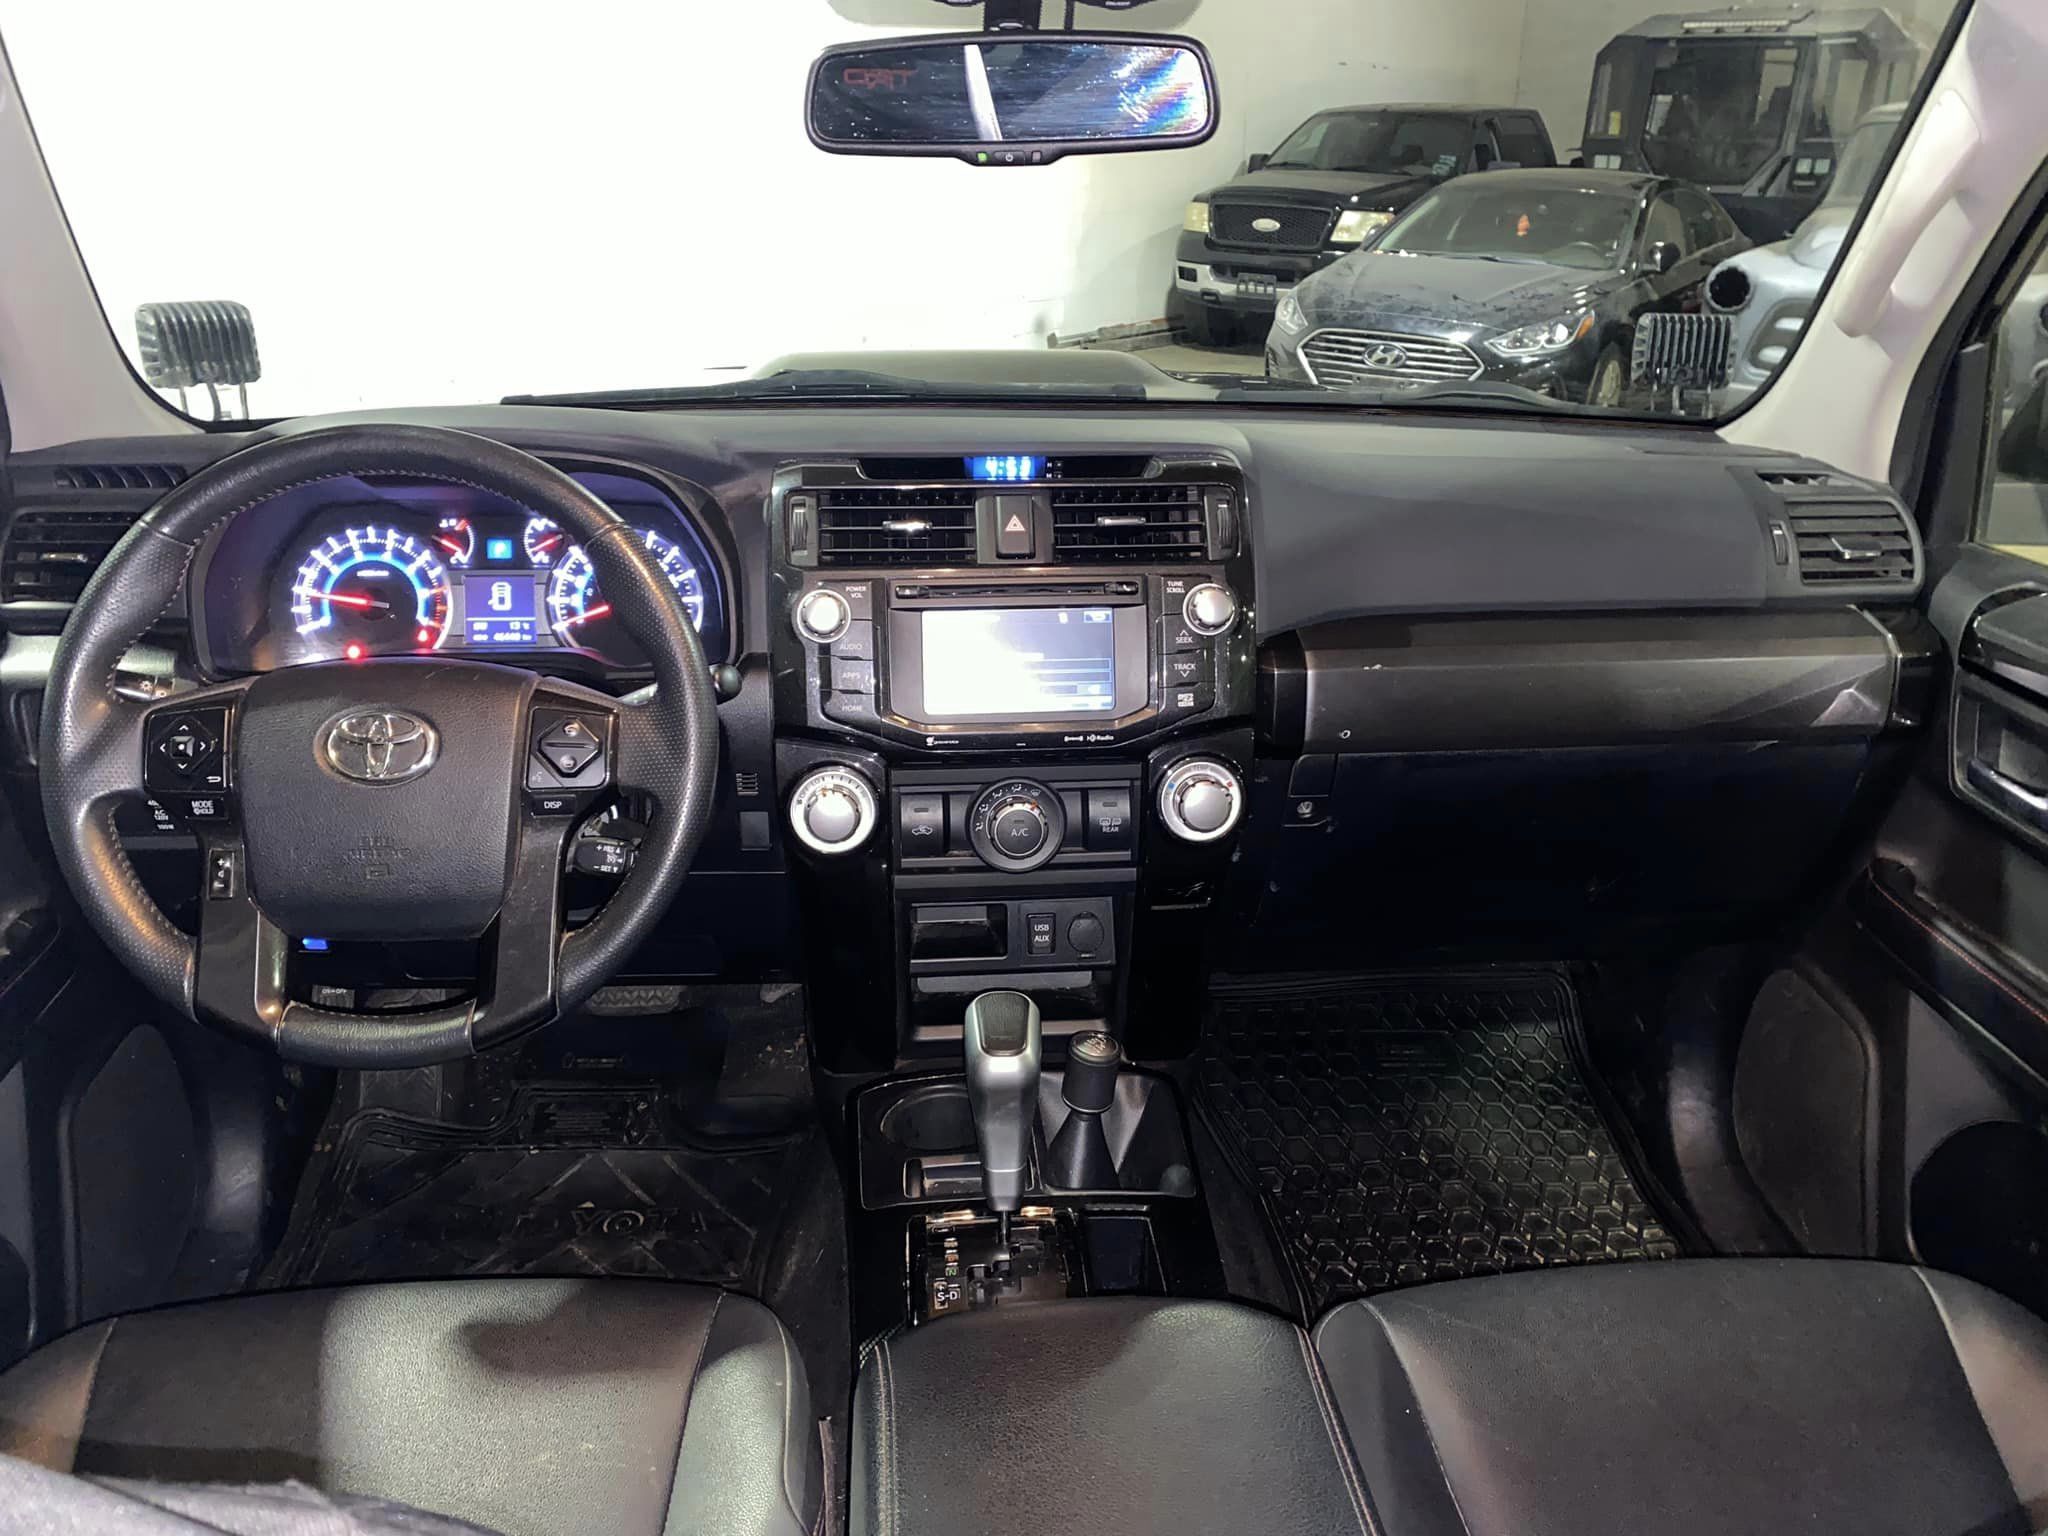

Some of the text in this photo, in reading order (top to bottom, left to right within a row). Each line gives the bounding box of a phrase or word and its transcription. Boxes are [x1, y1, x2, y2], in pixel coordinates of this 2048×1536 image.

[840, 643, 863, 651] AUDIO
[842, 704, 863, 712] HOME
[191, 800, 214, 808] MODE
[543, 801, 562, 809] DISP
[1011, 828, 1030, 837] A/C
[1034, 924, 1050, 932] USB
[1034, 935, 1050, 943] AUX
